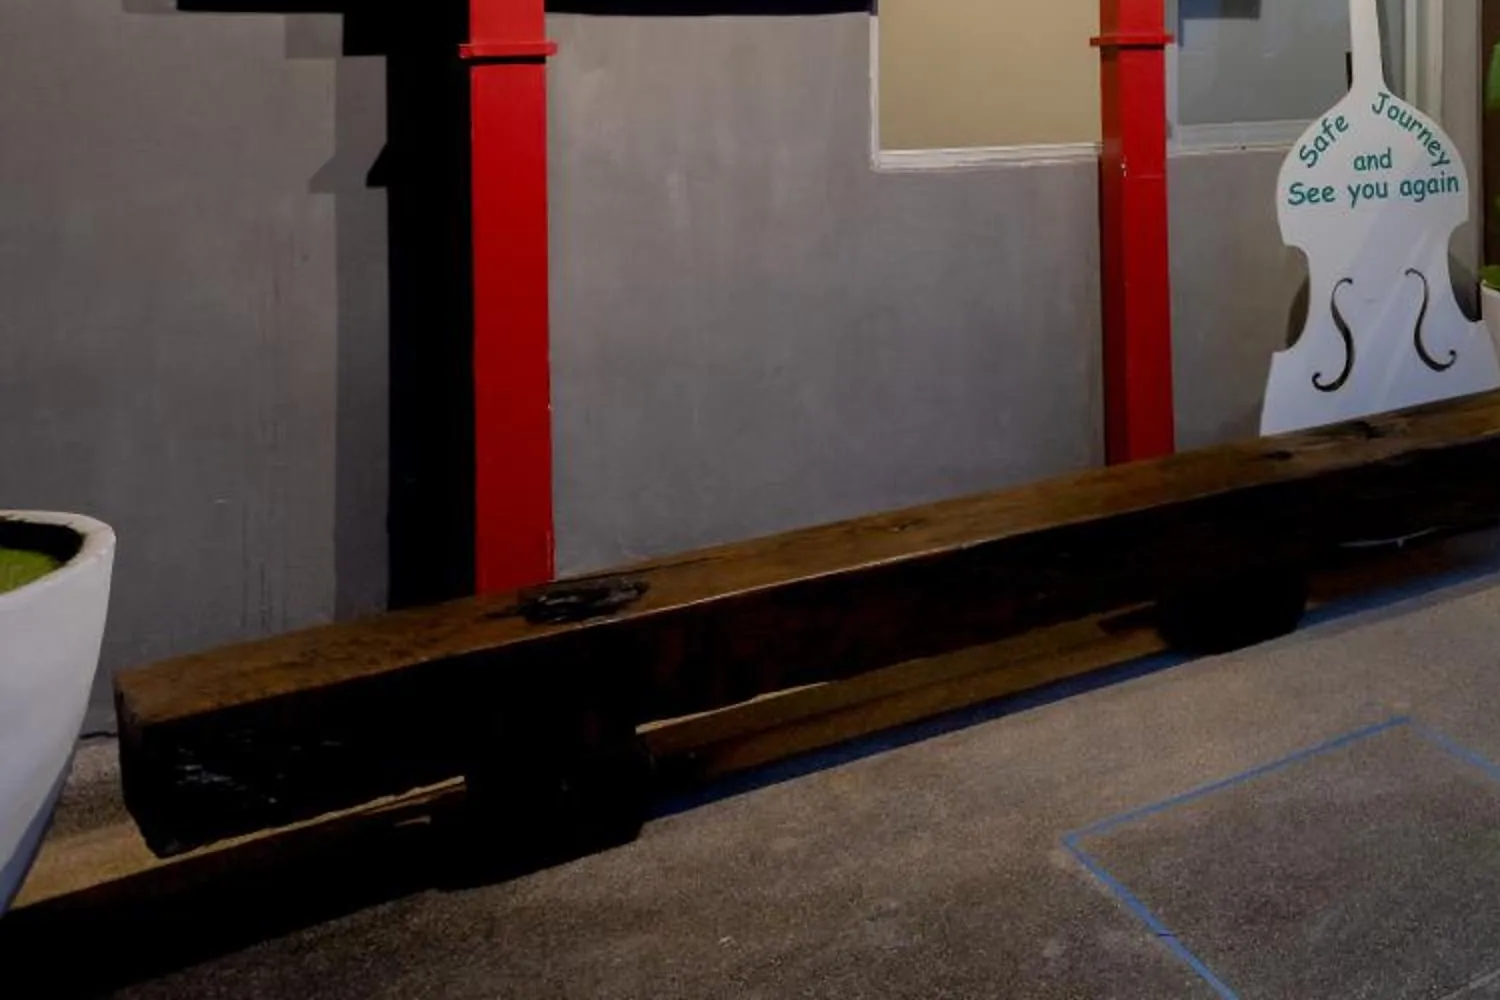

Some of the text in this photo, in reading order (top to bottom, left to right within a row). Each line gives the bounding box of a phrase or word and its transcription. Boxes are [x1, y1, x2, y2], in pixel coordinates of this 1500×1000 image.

[1299, 91, 1451, 168] Safe Journey
[1353, 147, 1393, 171] and
[1288, 171, 1459, 208] See you again
